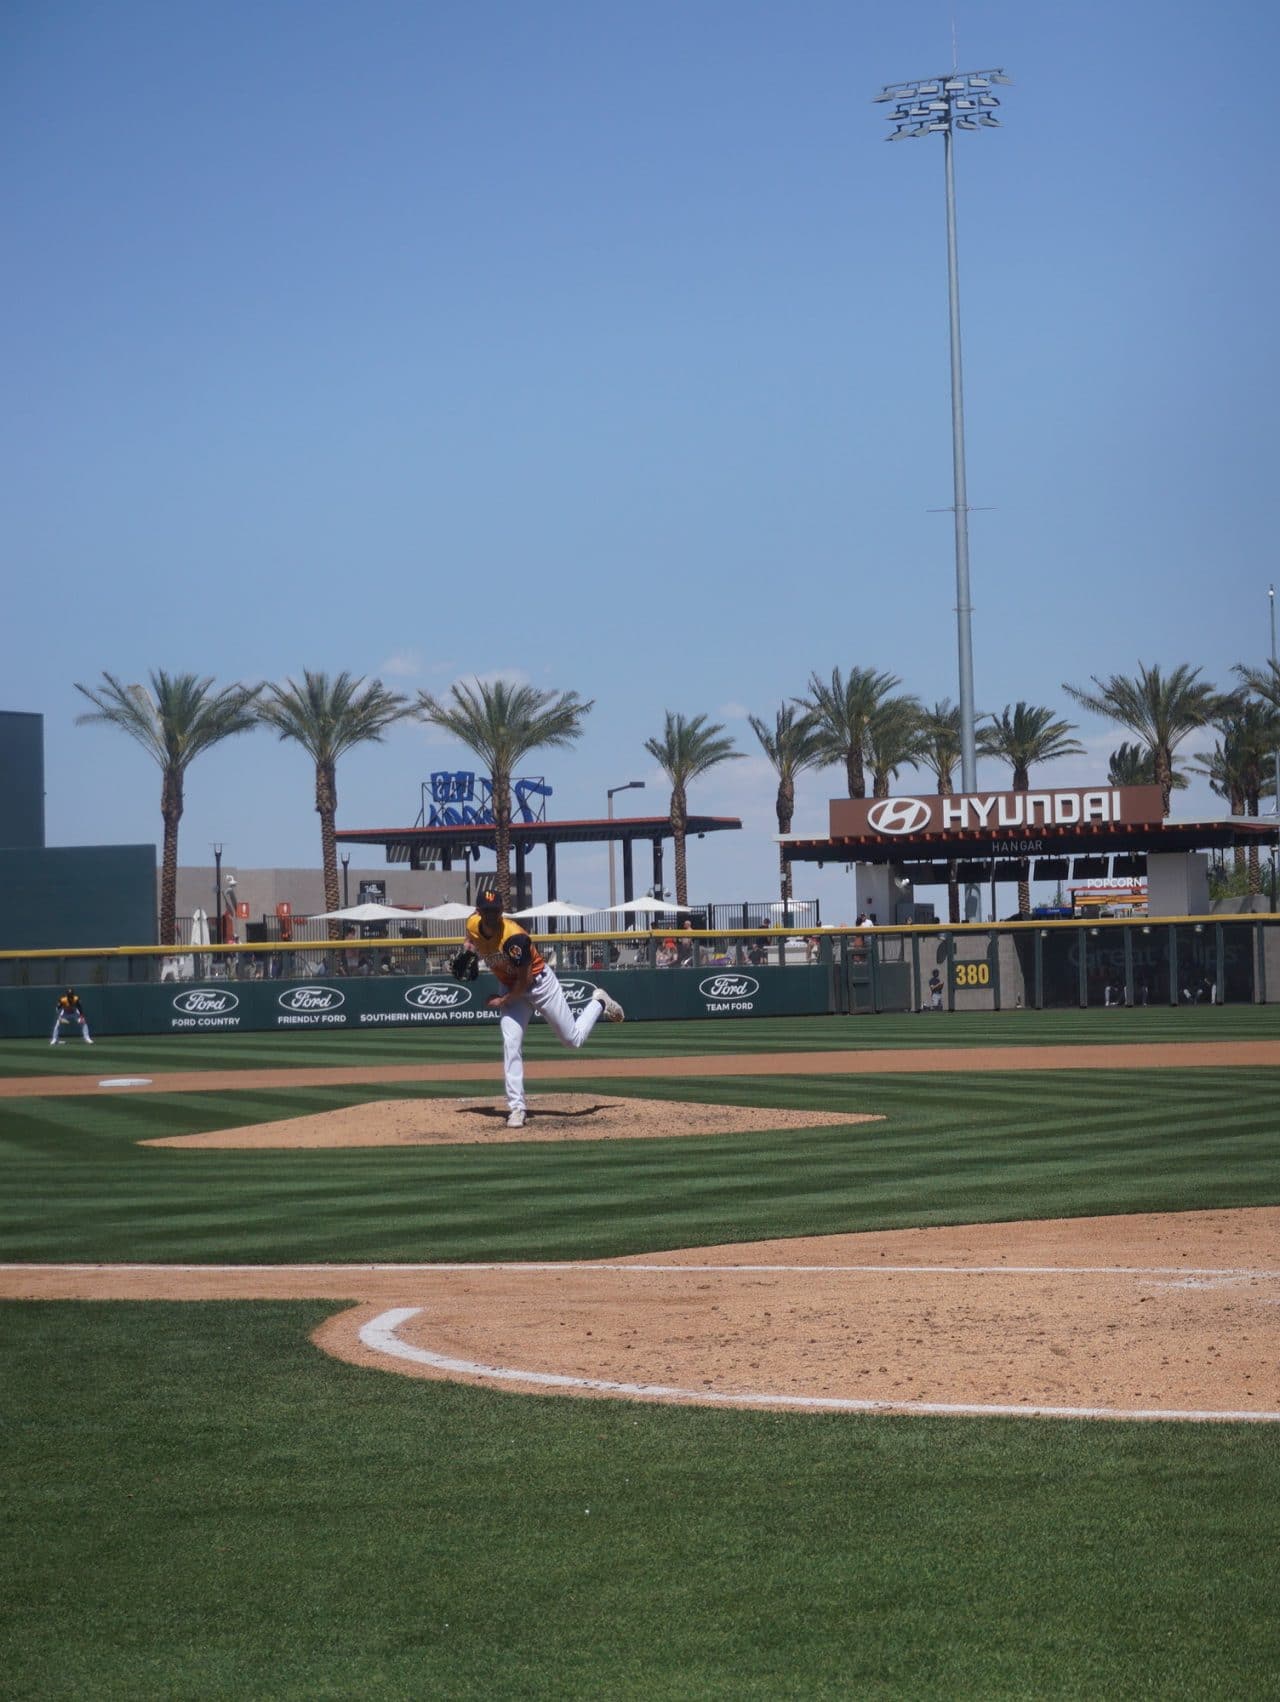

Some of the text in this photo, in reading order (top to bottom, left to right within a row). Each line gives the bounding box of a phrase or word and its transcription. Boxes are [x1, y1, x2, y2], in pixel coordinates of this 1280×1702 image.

[942, 791, 1121, 829] HYUNDAI
[992, 839, 1043, 852] HANGAR
[1087, 877, 1142, 889] POPCORN
[956, 963, 989, 985] 380
[711, 977, 748, 996] Ford
[185, 993, 226, 1010] Ford
[290, 989, 332, 1008] Ford
[418, 986, 459, 1004] Ford
[706, 1002, 754, 1012] TEAM FORD
[172, 1017, 241, 1027] FORD COUNTRY
[278, 1014, 347, 1024] FRIENDLY FORD
[360, 1010, 501, 1022] SOUTHERN NEVADA FORD DEAL
